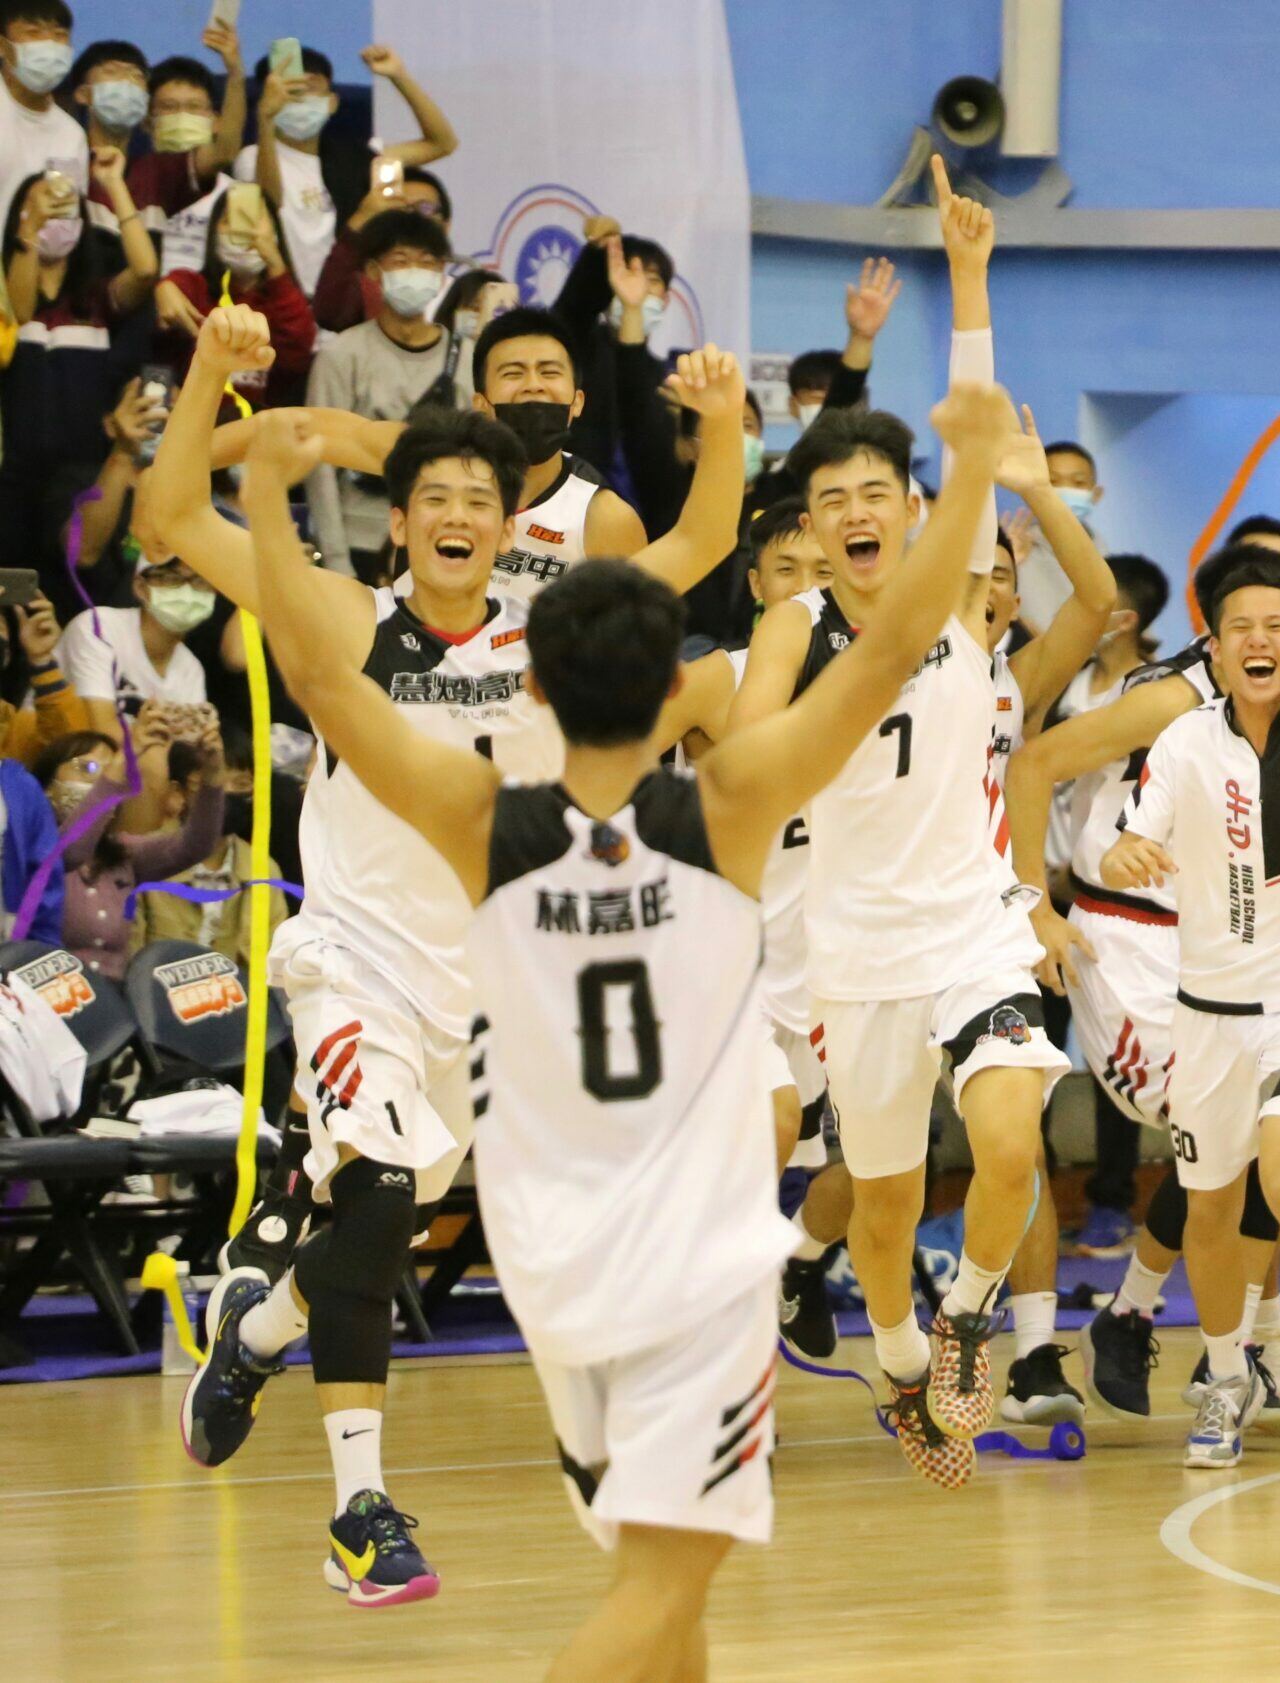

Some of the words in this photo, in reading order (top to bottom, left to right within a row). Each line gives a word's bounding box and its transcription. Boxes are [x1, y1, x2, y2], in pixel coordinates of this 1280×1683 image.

[494, 546, 569, 582] 高中
[879, 712, 913, 779] 7
[1228, 862, 1240, 935] BASKETBALL
[1241, 864, 1253, 895] HIGH
[1242, 898, 1255, 944] SCHOOL
[20, 953, 77, 989] EIDER
[158, 955, 231, 988] WEIDER
[577, 956, 664, 1104] 0
[384, 1100, 404, 1136] 1
[1170, 1122, 1198, 1163] 30
